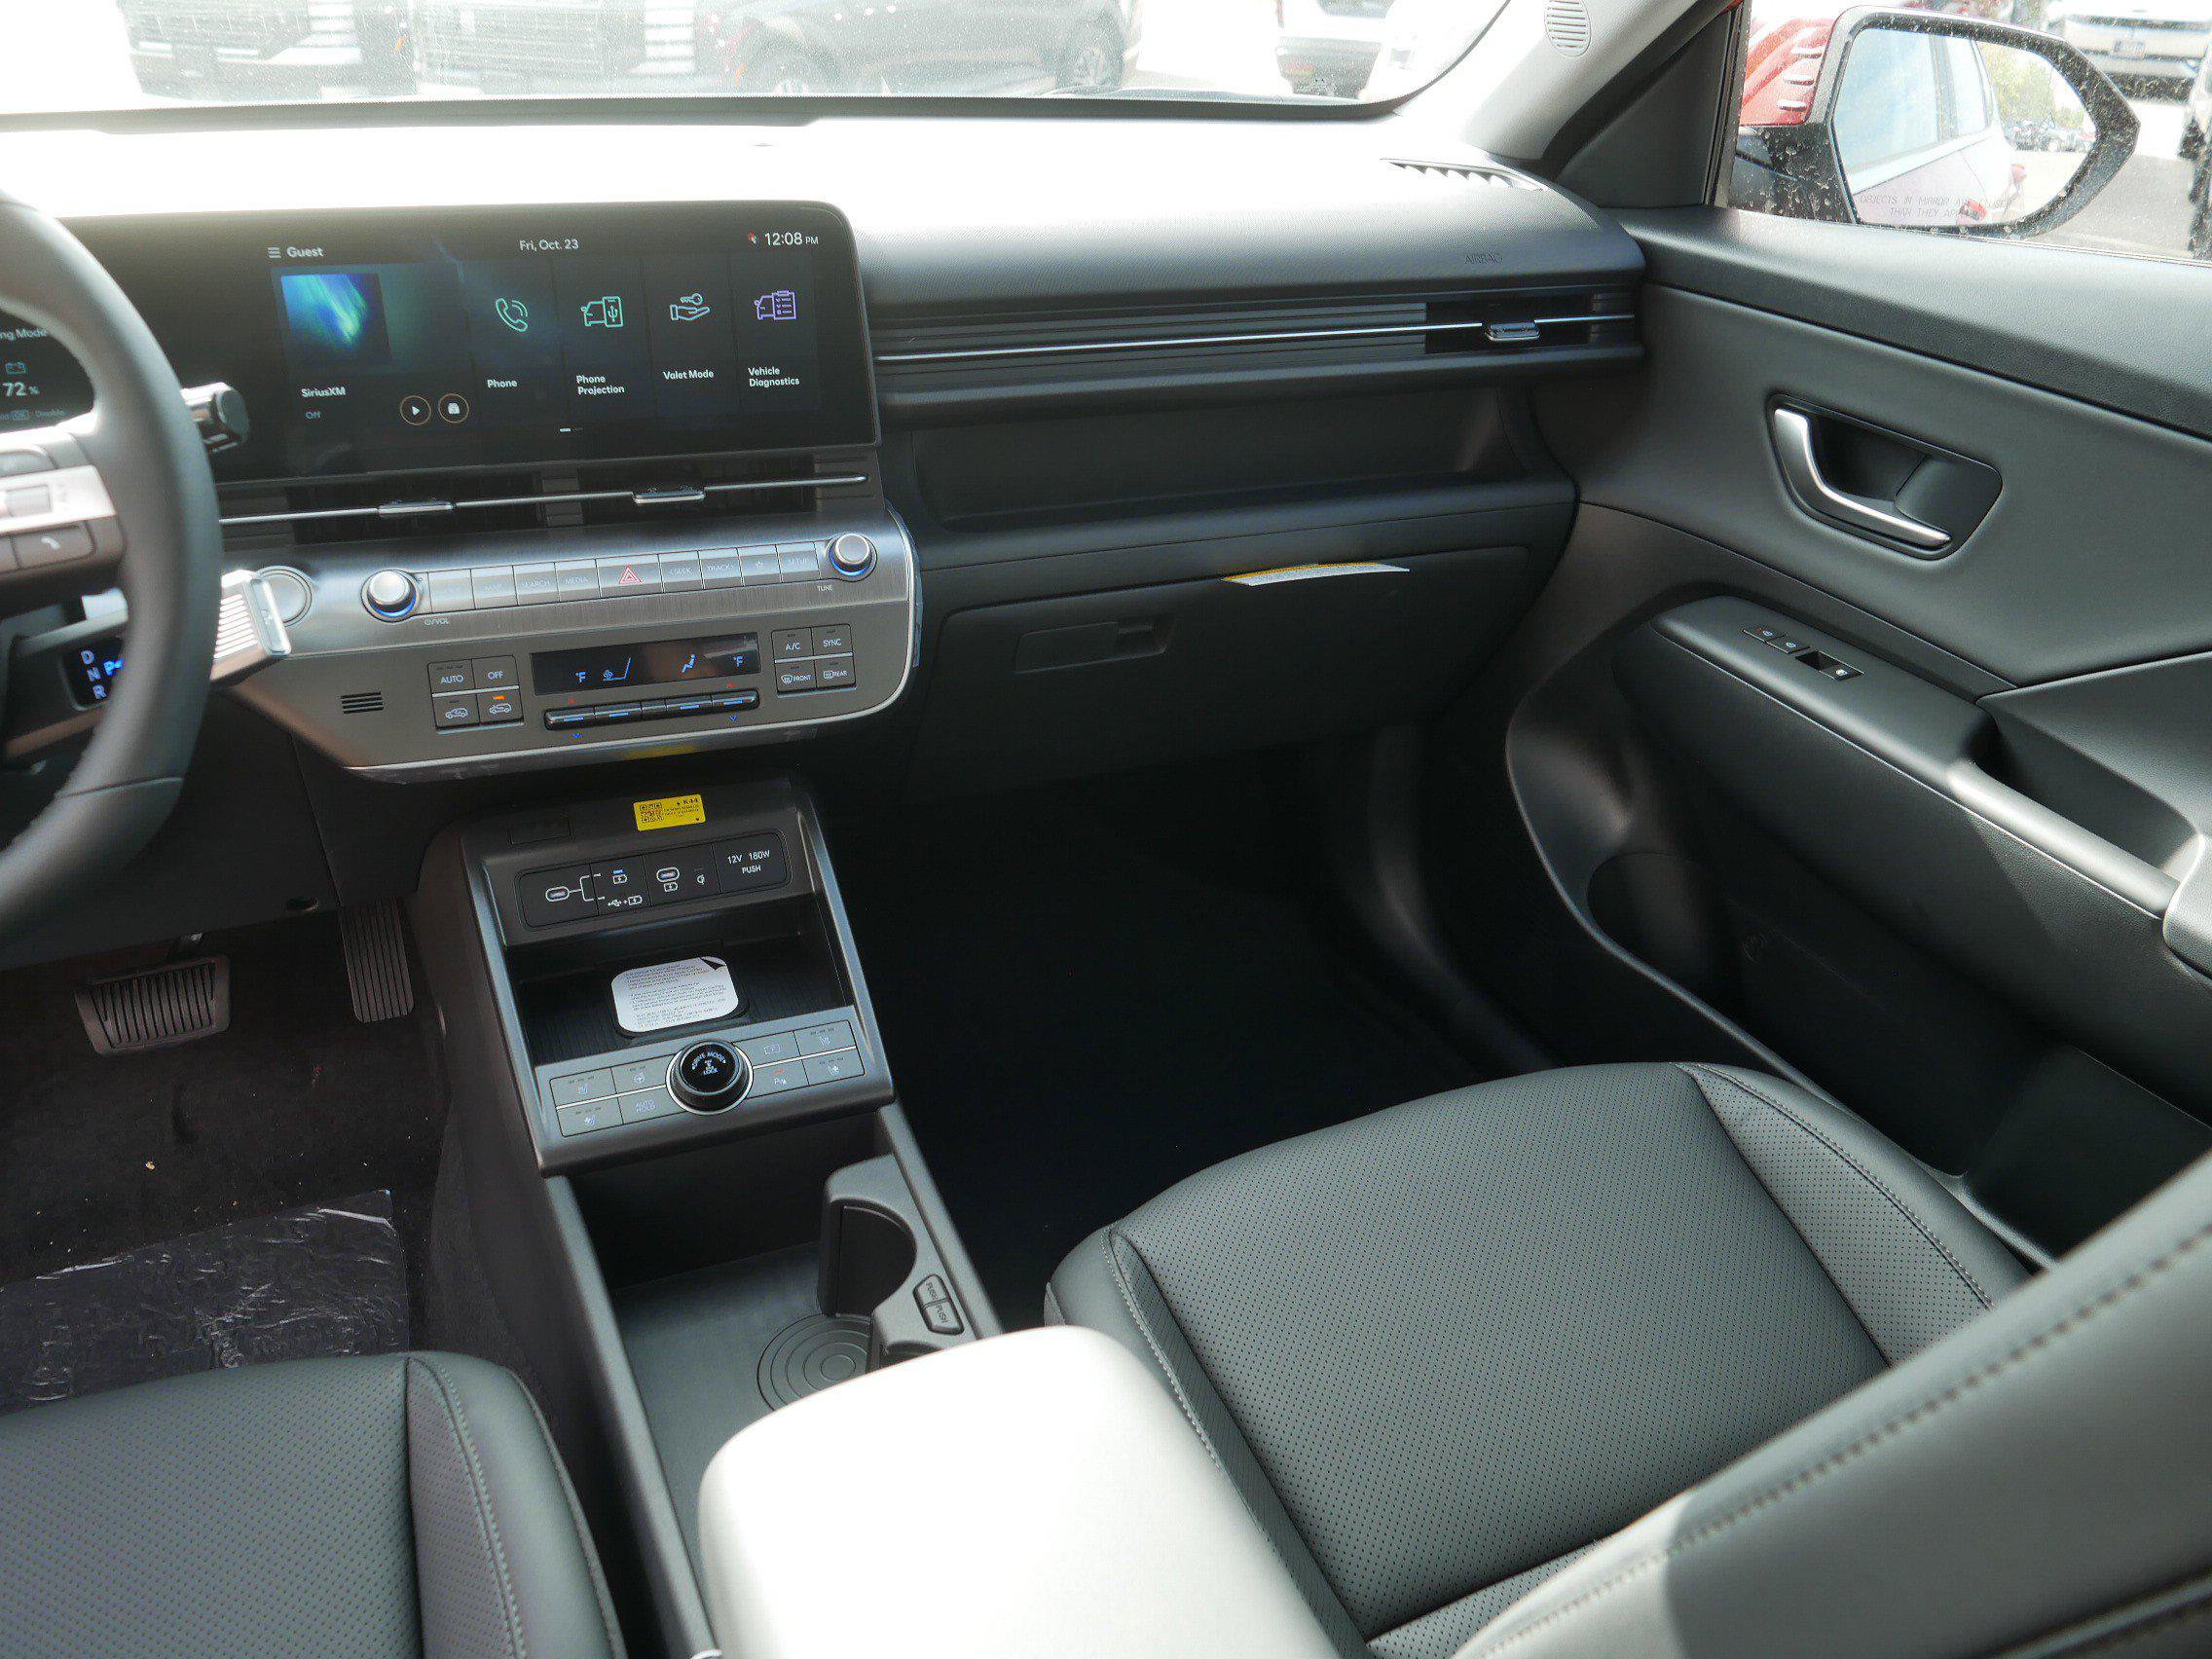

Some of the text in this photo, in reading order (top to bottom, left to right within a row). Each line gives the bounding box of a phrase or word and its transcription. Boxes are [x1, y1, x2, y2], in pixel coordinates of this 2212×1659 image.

[764, 232, 819, 246] 12:08 PM
[519, 238, 579, 252] Fri, Oct. 23
[286, 246, 324, 258] Guest
[1464, 252, 1504, 266] AIRBAG
[662, 369, 715, 381] Valet Mode
[748, 366, 781, 376] Vehicle
[487, 378, 518, 388] Phone
[575, 374, 607, 384] Phone
[749, 377, 800, 387] Diagnostics
[301, 387, 347, 398] SiriusXM
[577, 385, 625, 395] Projection
[785, 642, 801, 651] A/C
[823, 638, 842, 648] SYNC
[81, 649, 94, 665] D
[88, 667, 101, 682] N
[440, 674, 464, 684] AUTO
[487, 670, 503, 681] OFF
[92, 684, 107, 700] R
[727, 849, 770, 865] 12V 180W
[741, 865, 761, 874] PUSH
